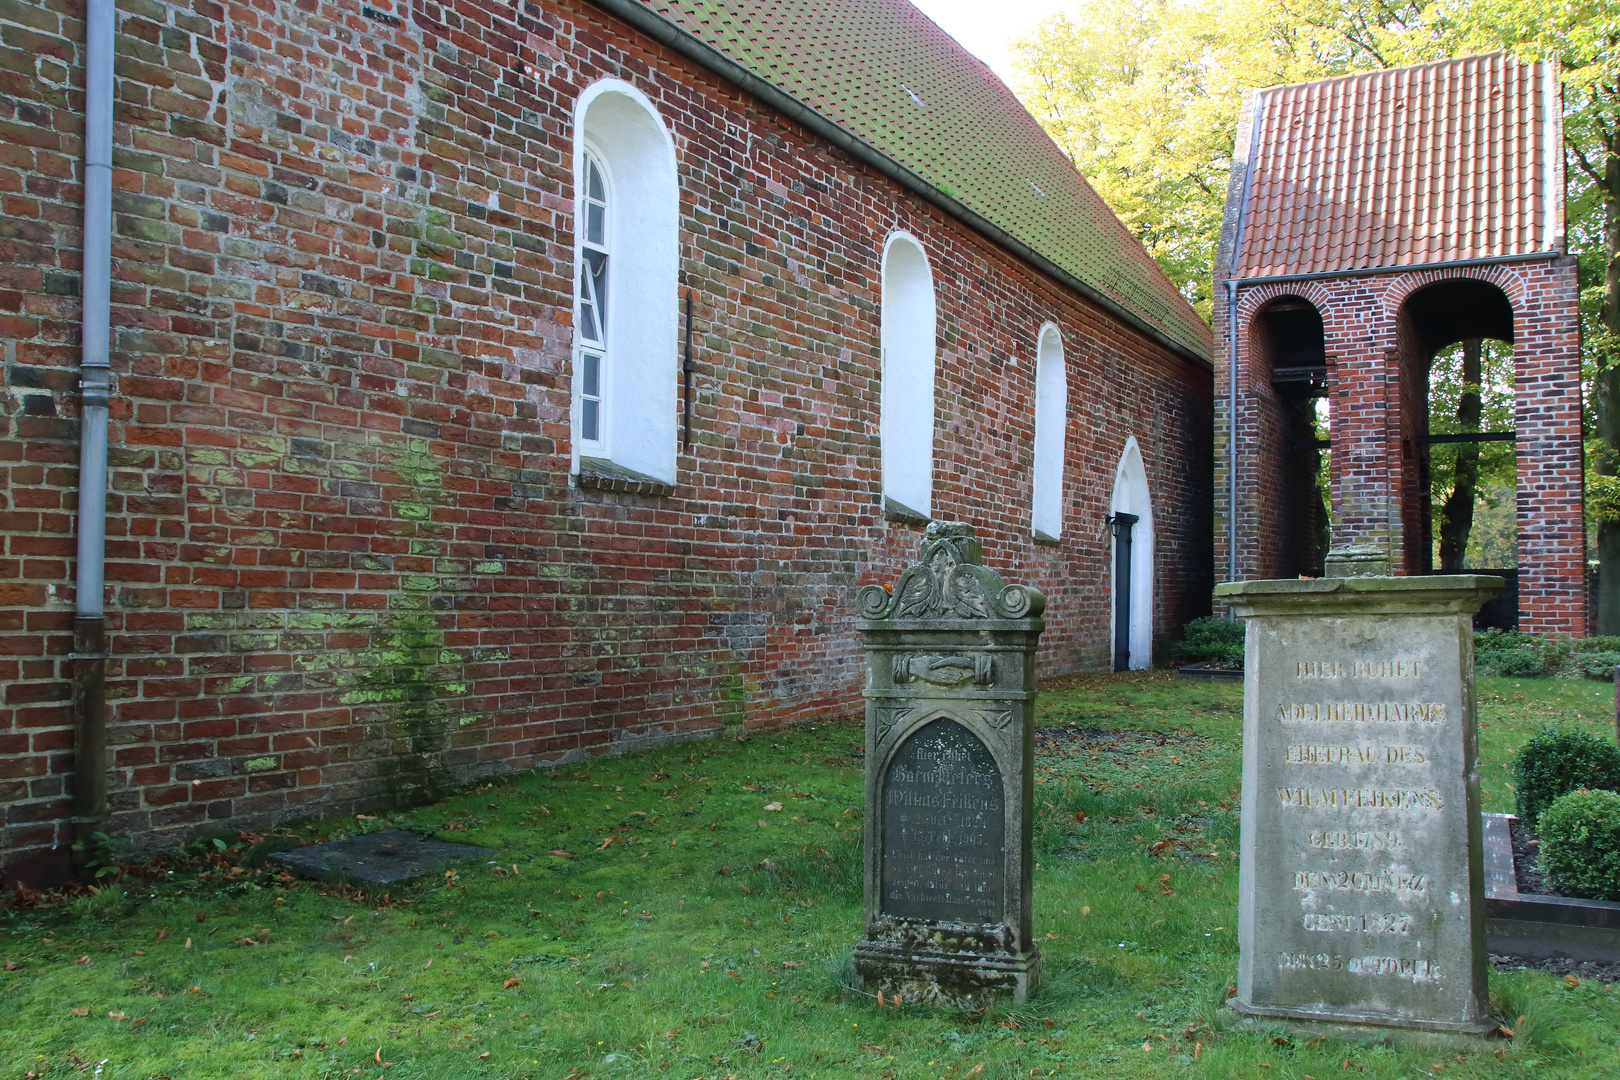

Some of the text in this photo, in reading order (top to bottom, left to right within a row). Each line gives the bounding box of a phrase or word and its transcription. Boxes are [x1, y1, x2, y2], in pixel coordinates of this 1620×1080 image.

[1296, 661, 1422, 678] HIER RUHET
[1376, 703, 1445, 723] HARMS
[1285, 745, 1428, 764] EHEFRAU DES
[1278, 787, 1336, 806] WILM
